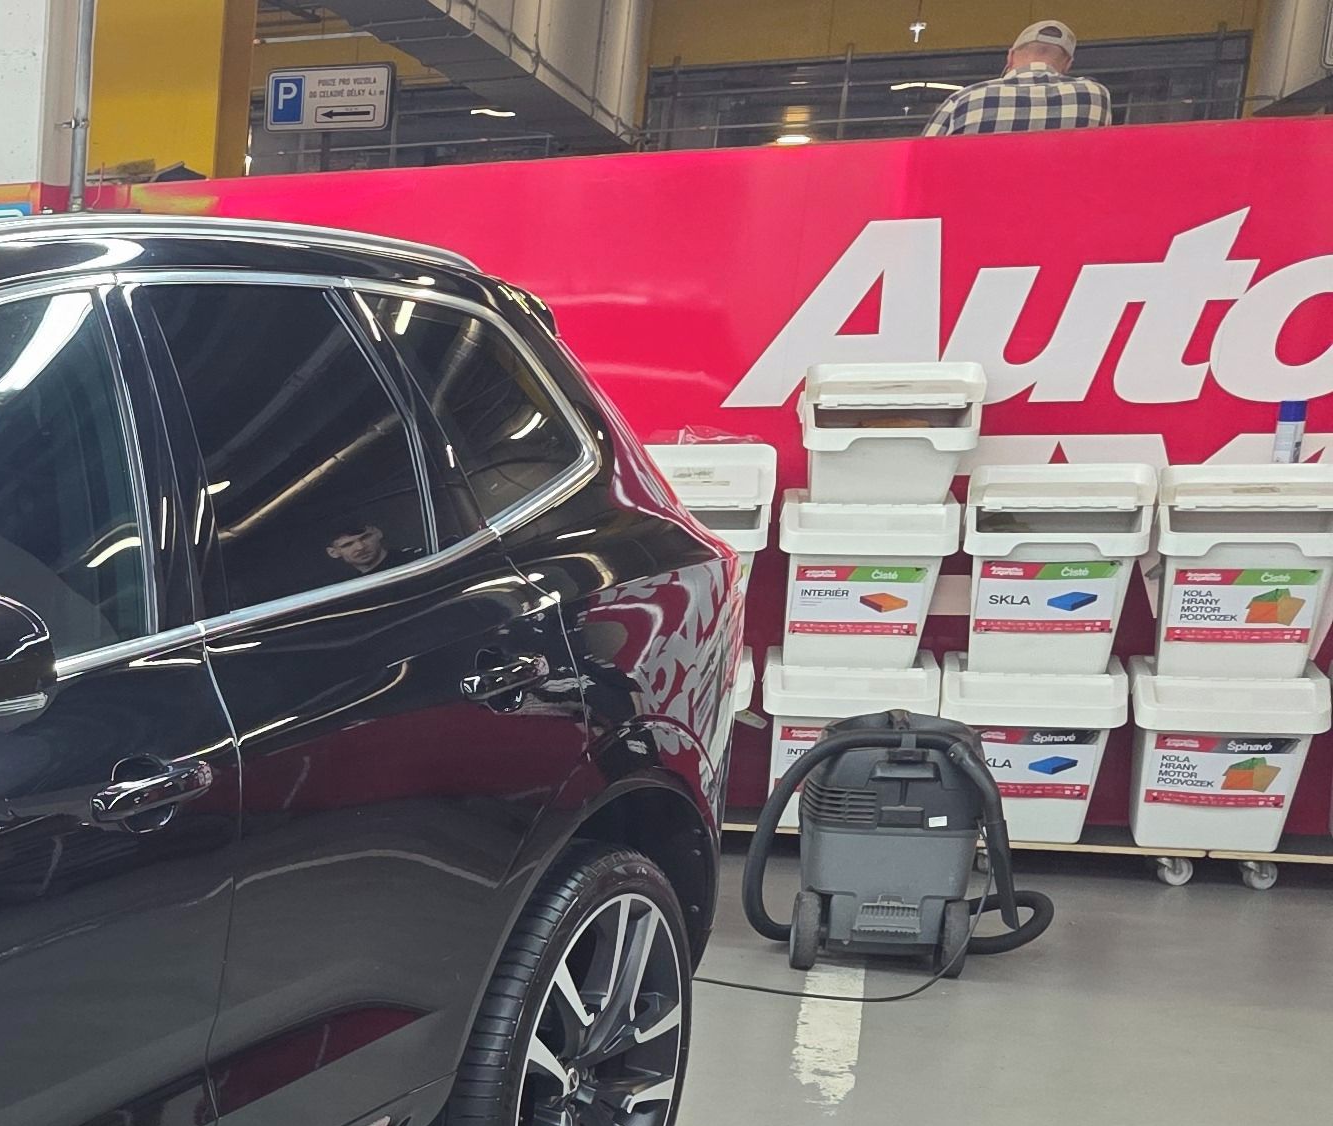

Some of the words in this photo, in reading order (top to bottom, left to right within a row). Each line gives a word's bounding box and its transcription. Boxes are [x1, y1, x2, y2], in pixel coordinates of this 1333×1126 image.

[278, 82, 298, 110] P
[800, 588, 850, 598] INTERIÉR
[1183, 589, 1213, 598] KOLA
[988, 594, 1031, 606] SKLA
[1181, 598, 1221, 606] HRANY
[1180, 606, 1222, 614] MOTOR
[1179, 614, 1238, 622] PODVOZEK
[1032, 732, 1076, 744] Špinavé
[1227, 740, 1273, 752] Špinavé
[984, 757, 1012, 769] KLA
[1161, 754, 1191, 764] KOLA
[1159, 762, 1198, 771] HRANY
[1158, 770, 1198, 779] MOTOR
[1156, 778, 1215, 788] PODVOZEK
